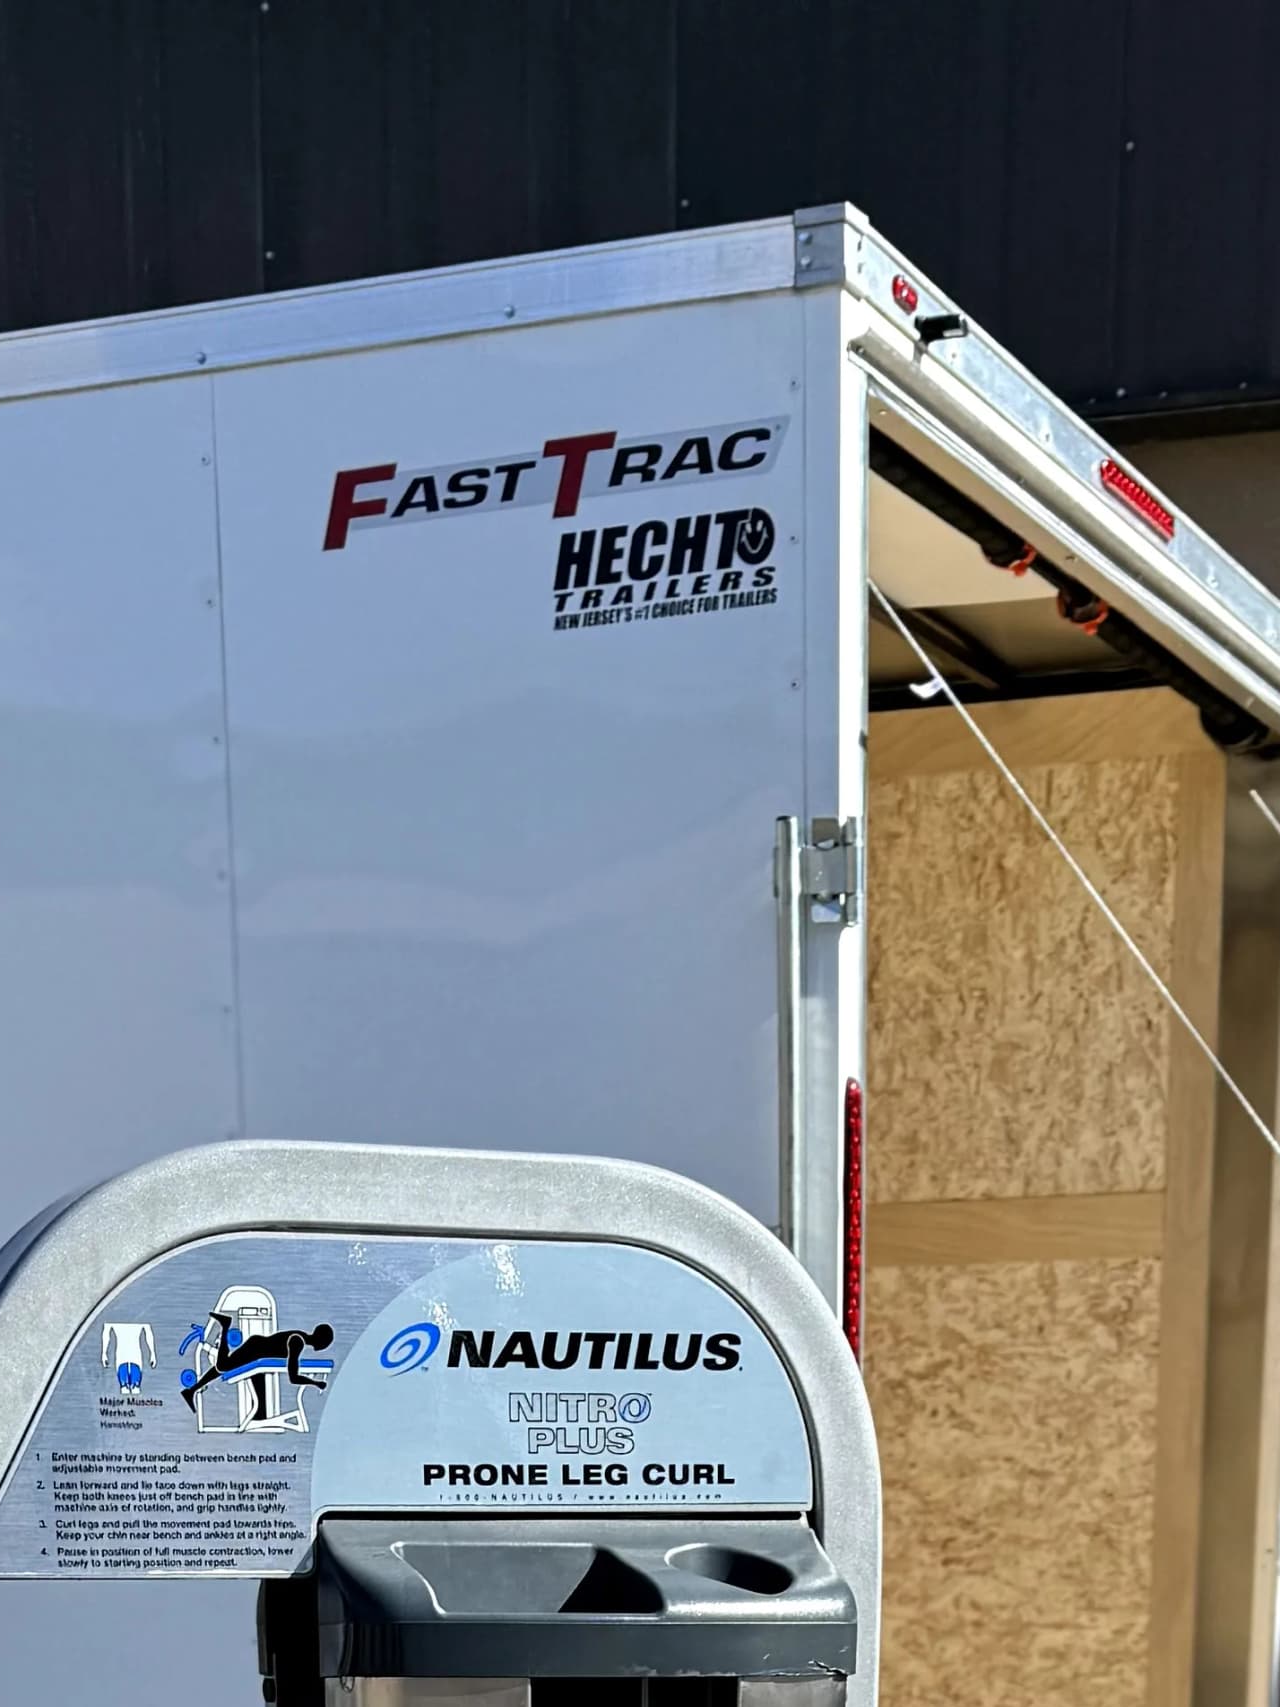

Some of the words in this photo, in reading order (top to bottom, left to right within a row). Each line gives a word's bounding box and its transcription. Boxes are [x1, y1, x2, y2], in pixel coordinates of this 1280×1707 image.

[554, 566, 775, 612] TRAILERS
[553, 613, 581, 631] NEW
[581, 607, 633, 628] JERSEY'S
[651, 599, 695, 619] CHOICE
[697, 596, 720, 613] FOR
[722, 588, 778, 609] TRAILERS
[447, 1330, 742, 1371] NAUTILUS
[99, 1397, 124, 1407] Major
[127, 1397, 163, 1407] Muscles
[508, 1392, 652, 1423] NITRO
[528, 1427, 635, 1455] PLUS
[51, 1452, 78, 1462] Enter
[80, 1453, 122, 1462] machine
[125, 1453, 137, 1464] by
[139, 1453, 181, 1464] standing
[183, 1454, 225, 1463] between
[227, 1454, 257, 1463] bench
[258, 1454, 276, 1464] pad
[279, 1454, 296, 1463] and
[52, 1464, 103, 1474] adjustable
[106, 1465, 157, 1473] movement
[159, 1464, 180, 1475] pad.
[423, 1463, 548, 1487] PRONE
[562, 1463, 628, 1486] LEG
[641, 1462, 735, 1485] CURL
[53, 1480, 77, 1490] Lean
[80, 1480, 118, 1490] forward
[121, 1481, 138, 1490] and
[141, 1481, 152, 1490] lie
[155, 1481, 176, 1490] face
[178, 1480, 205, 1490] down
[207, 1481, 228, 1490] with
[230, 1481, 249, 1491] legs
[54, 1492, 80, 1502] Keep
[82, 1492, 105, 1501] both
[107, 1492, 136, 1501] knees
[138, 1492, 157, 1502] just
[159, 1492, 172, 1501] off
[175, 1492, 204, 1501] bench
[206, 1492, 224, 1502] pad
[227, 1492, 235, 1501] in
[238, 1492, 254, 1501] line
[257, 1492, 277, 1501] with
[54, 1503, 96, 1512] machine
[99, 1503, 119, 1512] axis
[121, 1503, 131, 1512] of
[133, 1503, 174, 1513] rotation,
[176, 1503, 194, 1512] and
[197, 1503, 215, 1514] grip
[218, 1503, 255, 1512] handles
[55, 1520, 76, 1529] Curl
[78, 1520, 99, 1530] legs
[101, 1520, 119, 1529] and
[122, 1520, 140, 1529] pull
[143, 1520, 158, 1529] the
[160, 1520, 210, 1529] movement
[213, 1520, 231, 1529] pad
[234, 1520, 272, 1529] towards
[56, 1530, 81, 1541] Keep
[83, 1531, 104, 1541] your
[107, 1531, 127, 1540] chin
[129, 1531, 150, 1540] near
[153, 1531, 182, 1540] bench
[184, 1531, 202, 1540] and
[204, 1531, 234, 1540] ankles
[236, 1531, 245, 1540] at
[255, 1531, 277, 1541] right
[57, 1547, 87, 1556] Pause
[90, 1547, 99, 1556] in
[101, 1547, 140, 1557] position
[143, 1547, 152, 1556] of
[155, 1547, 170, 1556] full
[172, 1547, 206, 1556] muscle
[209, 1546, 266, 1557] contraction,
[268, 1547, 294, 1556] lower
[58, 1558, 88, 1569] slowly
[91, 1558, 101, 1567] to
[104, 1558, 141, 1569] starting
[143, 1558, 182, 1568] position
[184, 1558, 202, 1567] and
